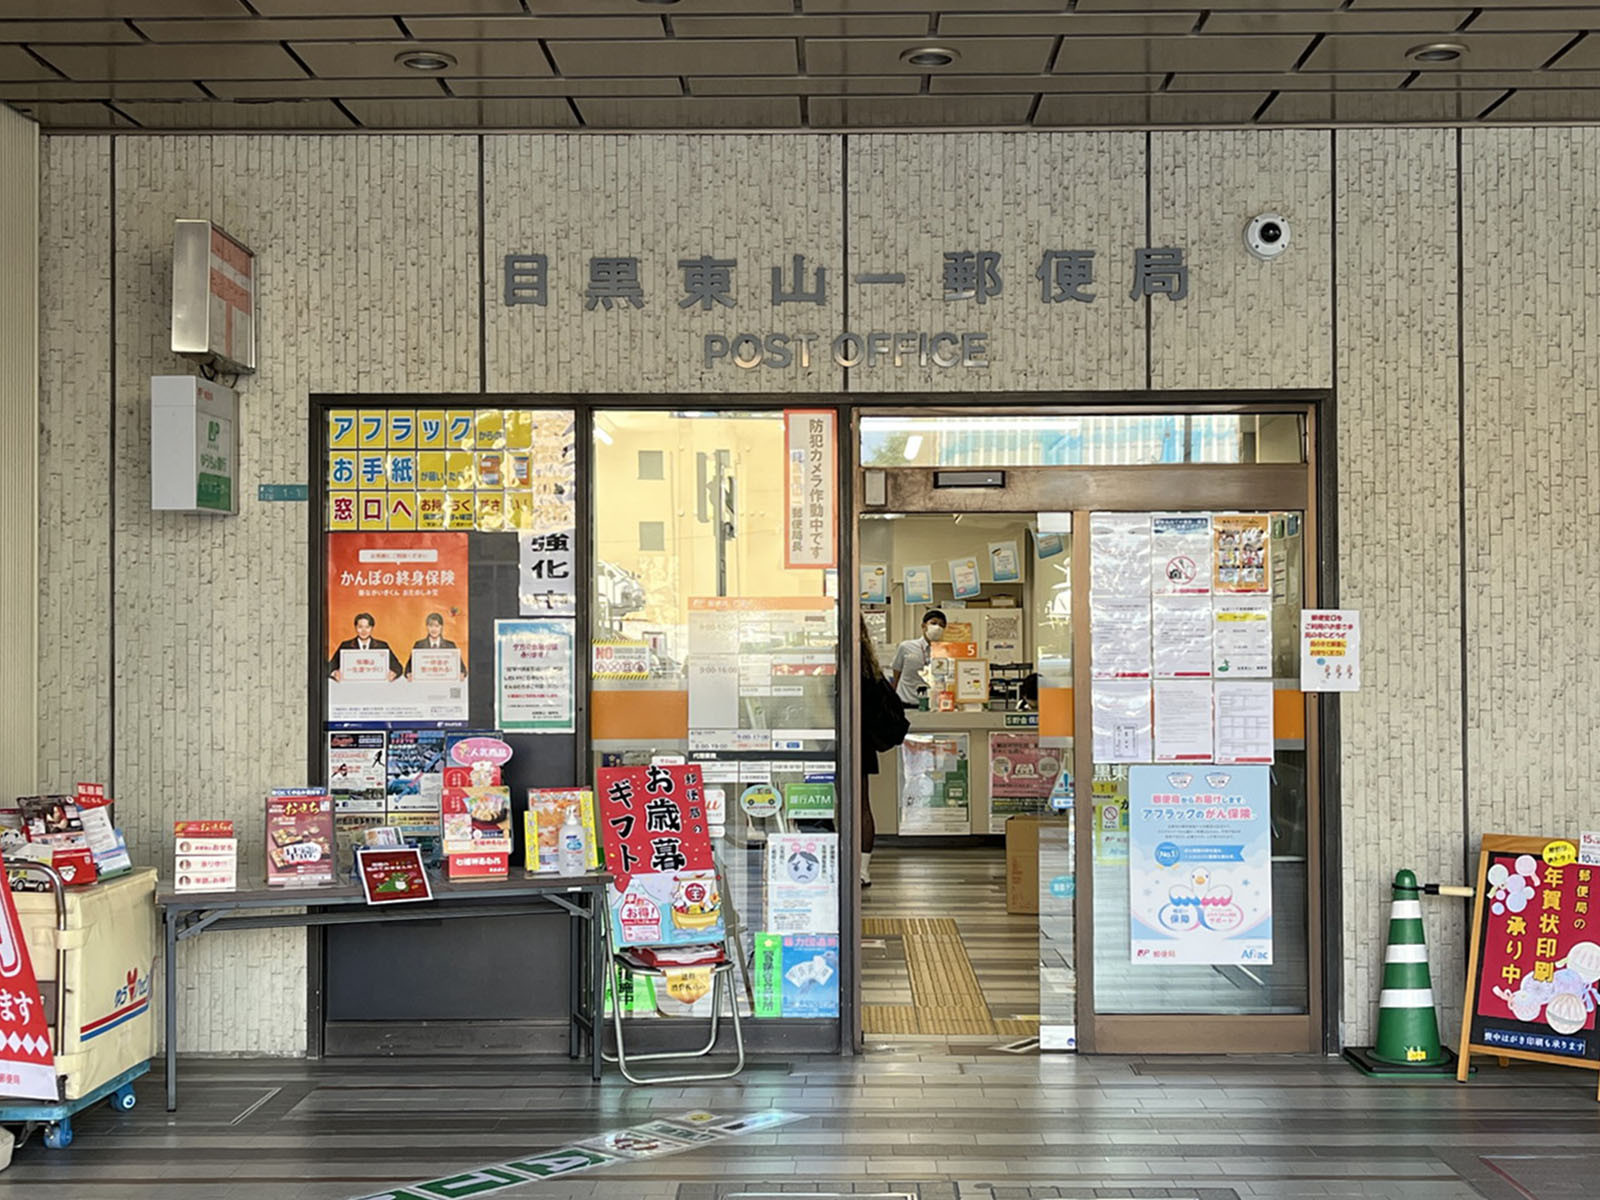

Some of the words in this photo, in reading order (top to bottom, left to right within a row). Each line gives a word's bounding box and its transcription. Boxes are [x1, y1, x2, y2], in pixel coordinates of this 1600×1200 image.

[504, 247, 1188, 311] 目黒東山一郵便局
[704, 334, 818, 369] POST
[833, 332, 989, 368] OFFICE
[333, 417, 471, 441] アフラック
[333, 458, 412, 482] お手紙
[809, 418, 824, 560] 防犯カメラ作動中です
[334, 498, 412, 520] 窓口へ
[341, 570, 455, 586] かんぽの終身保険
[595, 647, 613, 660] NO
[967, 644, 975, 656] 5
[609, 781, 638, 873] ギフト
[647, 765, 686, 872] お歳暮
[1143, 808, 1252, 819] アフラックのがん保険
[1573, 868, 1593, 930] 郵便局の
[1533, 867, 1564, 983] 年賀状印刷
[1241, 949, 1269, 959] Aflac
[1501, 915, 1527, 986] 承り中
[0, 988, 34, 1026] ます
[1484, 1031, 1585, 1051] 喪中はがき印刷も承ります
